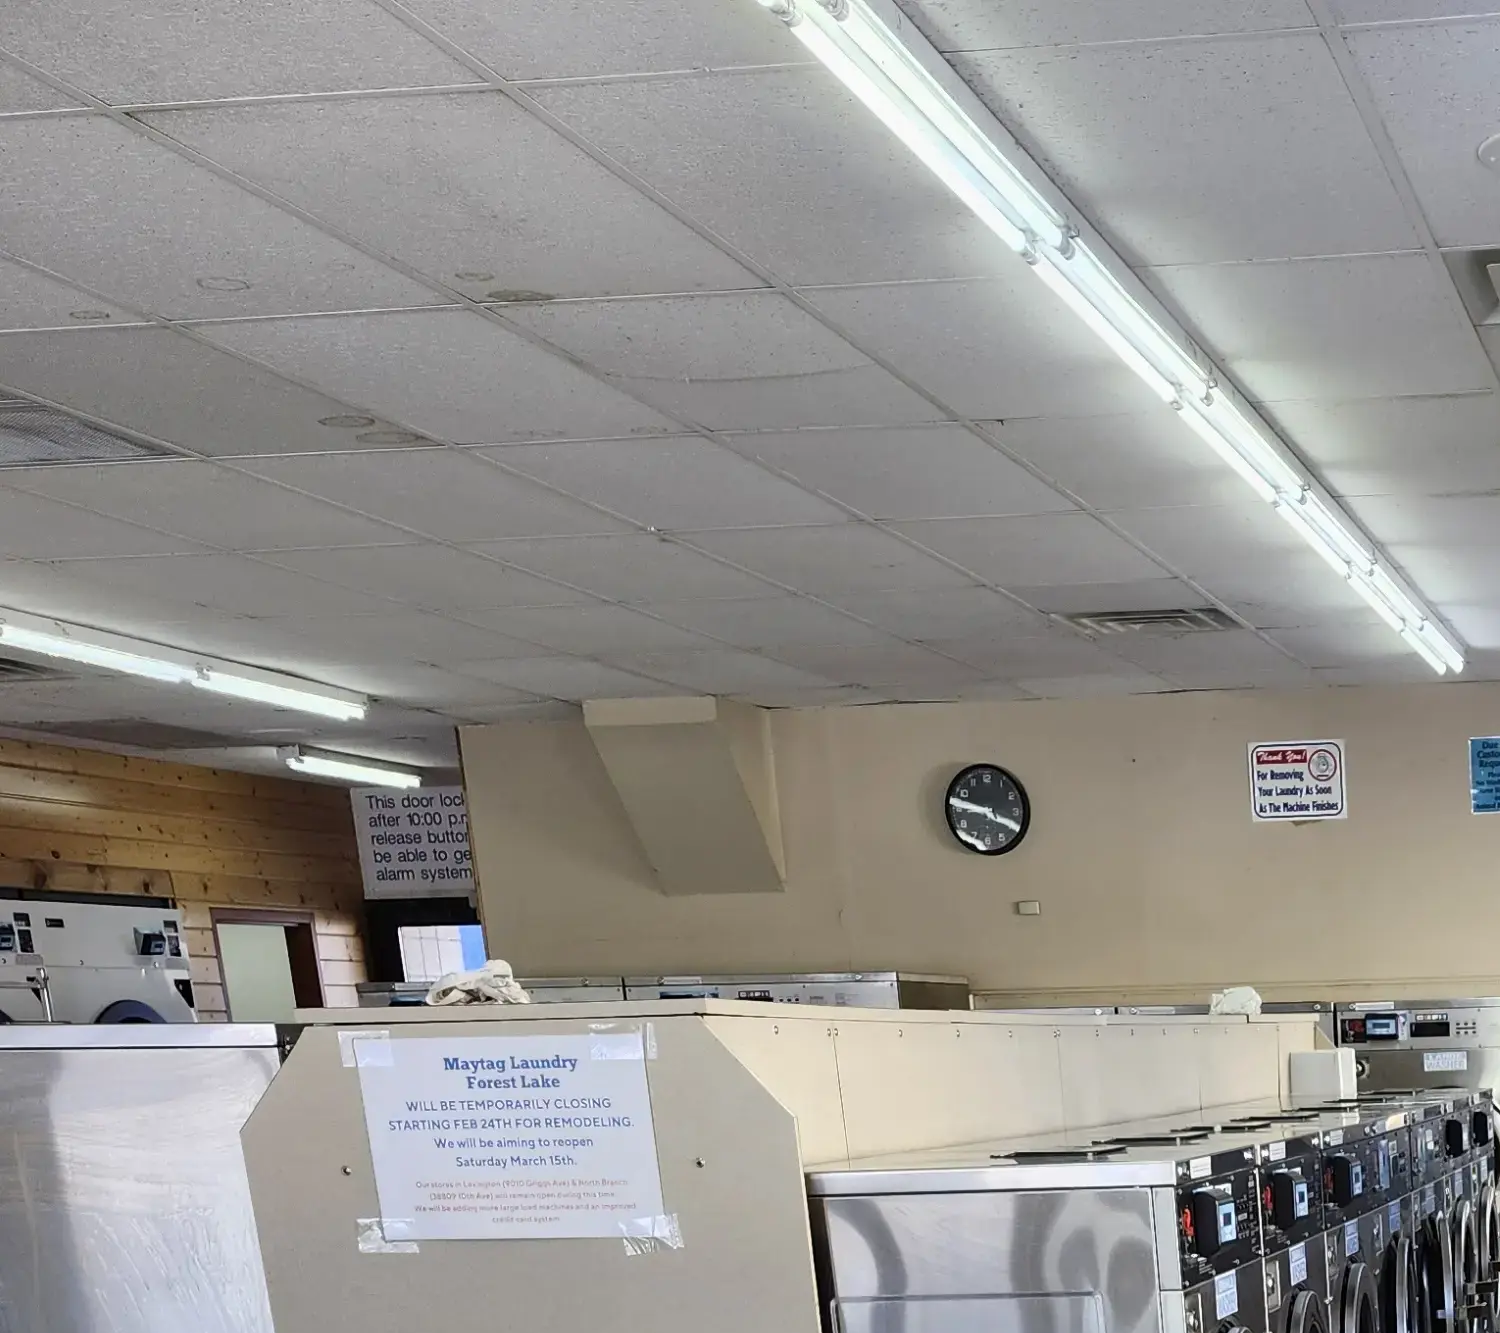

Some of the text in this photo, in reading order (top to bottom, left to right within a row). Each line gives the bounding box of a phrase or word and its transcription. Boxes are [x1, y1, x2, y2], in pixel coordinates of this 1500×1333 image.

[1257, 751, 1282, 761] Thank
[1257, 769, 1304, 781] For Removing
[1258, 785, 1332, 798] Your Laundry As Soon
[365, 795, 395, 809] This
[401, 794, 434, 808] door
[1259, 800, 1338, 813] As The Machine Finishes
[369, 813, 400, 827] after
[406, 811, 442, 826] 10:00
[371, 831, 421, 845] release
[373, 850, 392, 863] be
[398, 848, 427, 862] able
[433, 849, 447, 861] to
[376, 866, 472, 883] alarm system
[444, 1055, 578, 1074] Maytag Laundry
[467, 1075, 560, 1089] Forest Lake
[406, 1098, 611, 1112] WILL BE TEMPORARILY CLOSING
[389, 1117, 635, 1131] STARTING FEB 24TH FOR REMODELING.
[434, 1137, 593, 1150] We will be aiming to reopen
[456, 1155, 578, 1169] Saturday March 15th.
